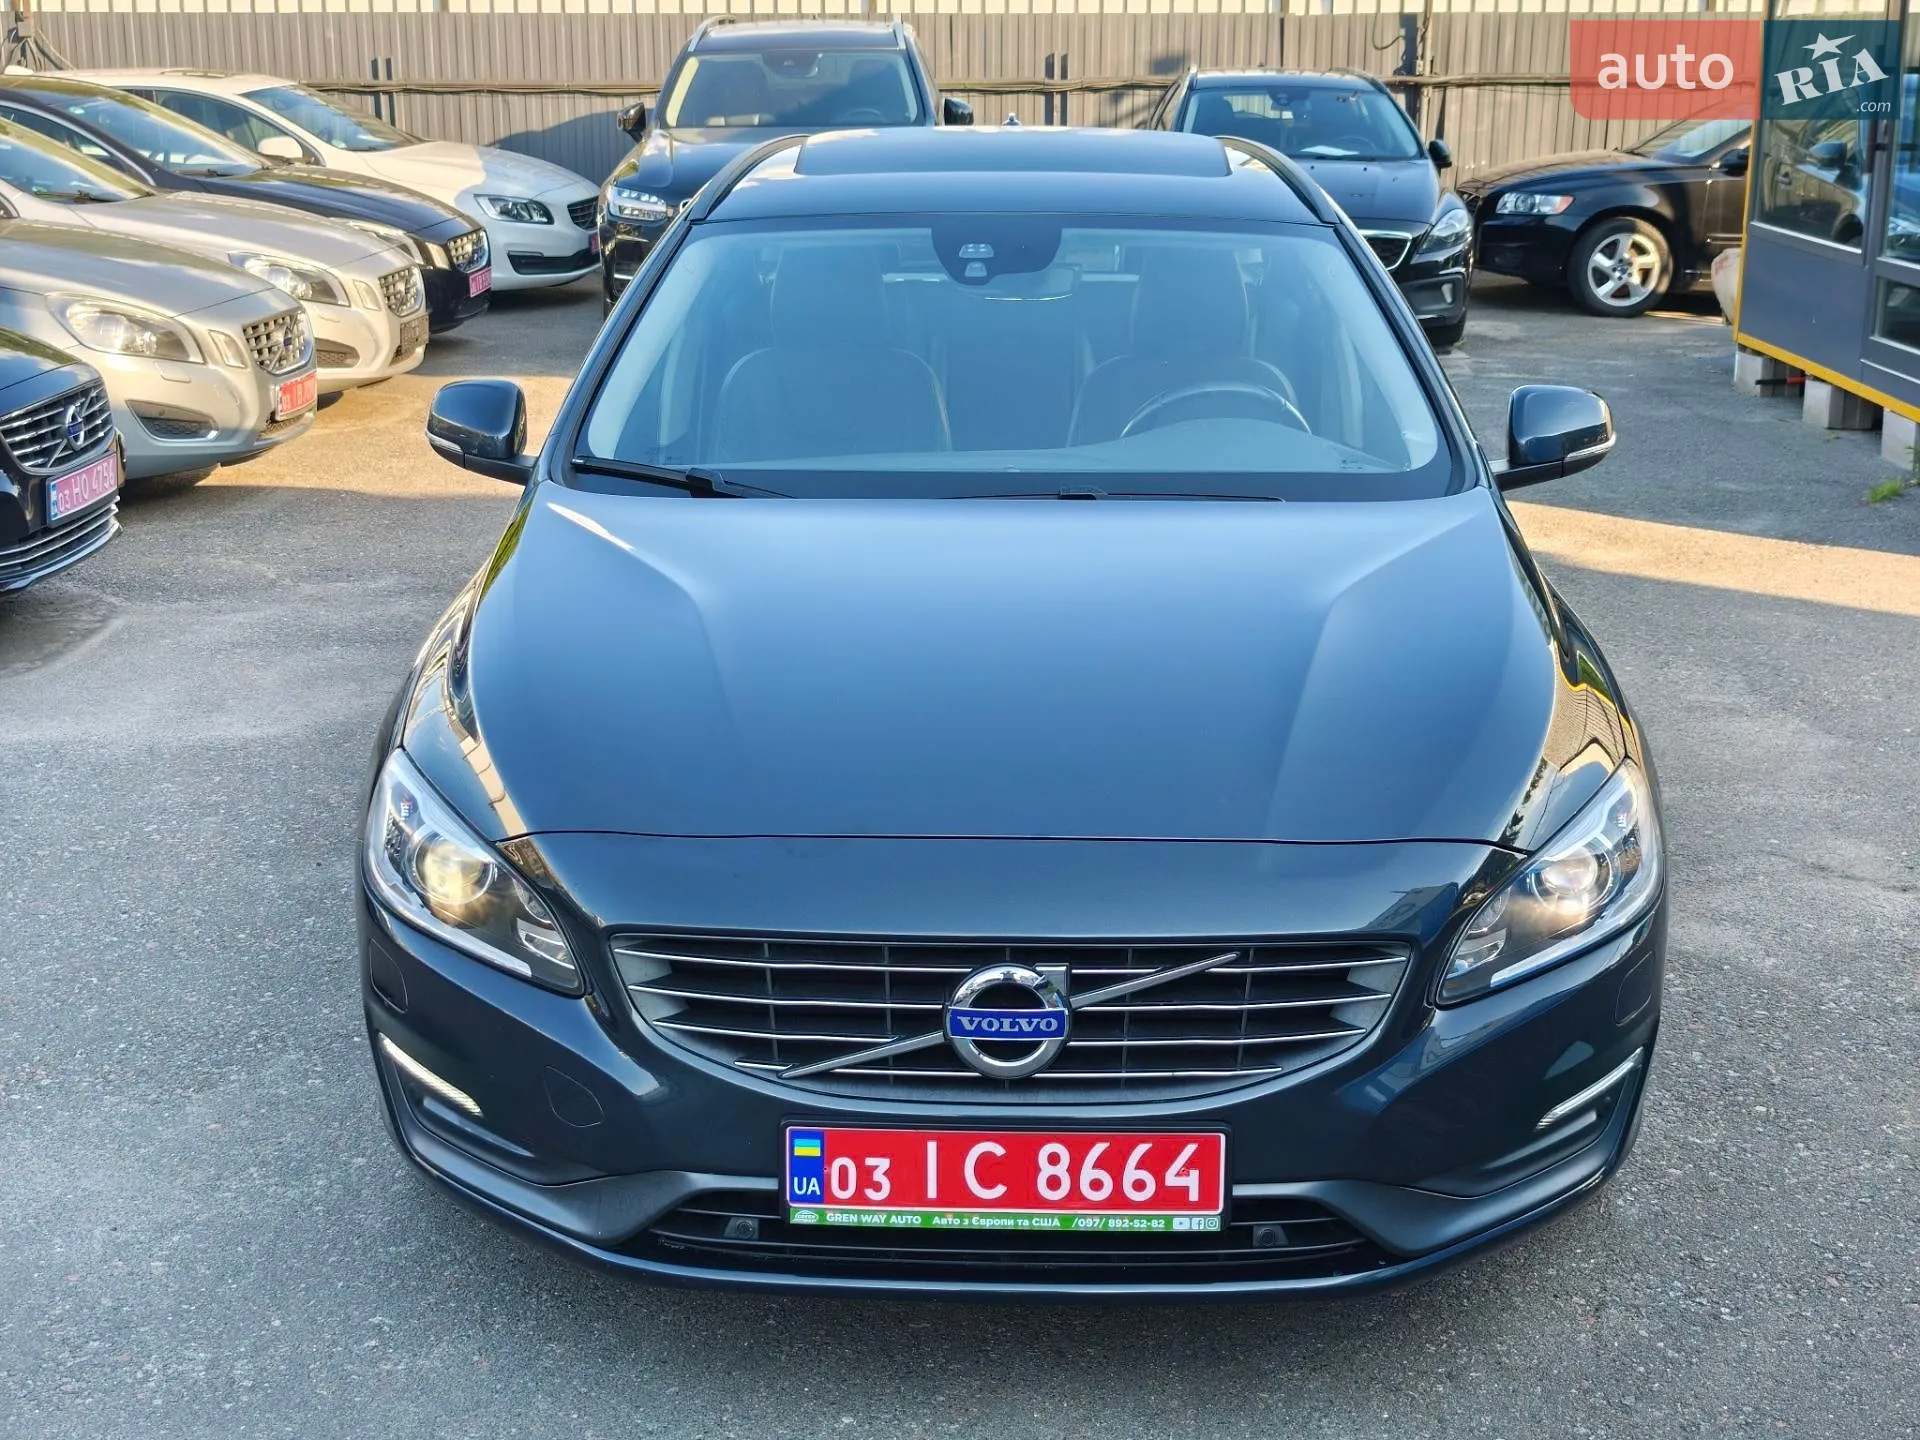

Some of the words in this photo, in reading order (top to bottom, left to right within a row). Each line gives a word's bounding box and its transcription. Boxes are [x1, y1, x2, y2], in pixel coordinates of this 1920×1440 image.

[58, 489, 71, 512] 03
[957, 1015, 1059, 1032] VOLVO
[830, 1156, 891, 1201] 03
[1036, 1141, 1200, 1202] 8664
[793, 1176, 821, 1196] UA
[826, 1213, 859, 1224] GREN
[860, 1214, 888, 1224] WAY
[889, 1214, 922, 1225] AUTO
[932, 1216, 961, 1226] Авто
[1016, 1218, 1030, 1227] та
[1031, 1217, 1061, 1227] США
[1108, 1218, 1165, 1228] 892-52-82
